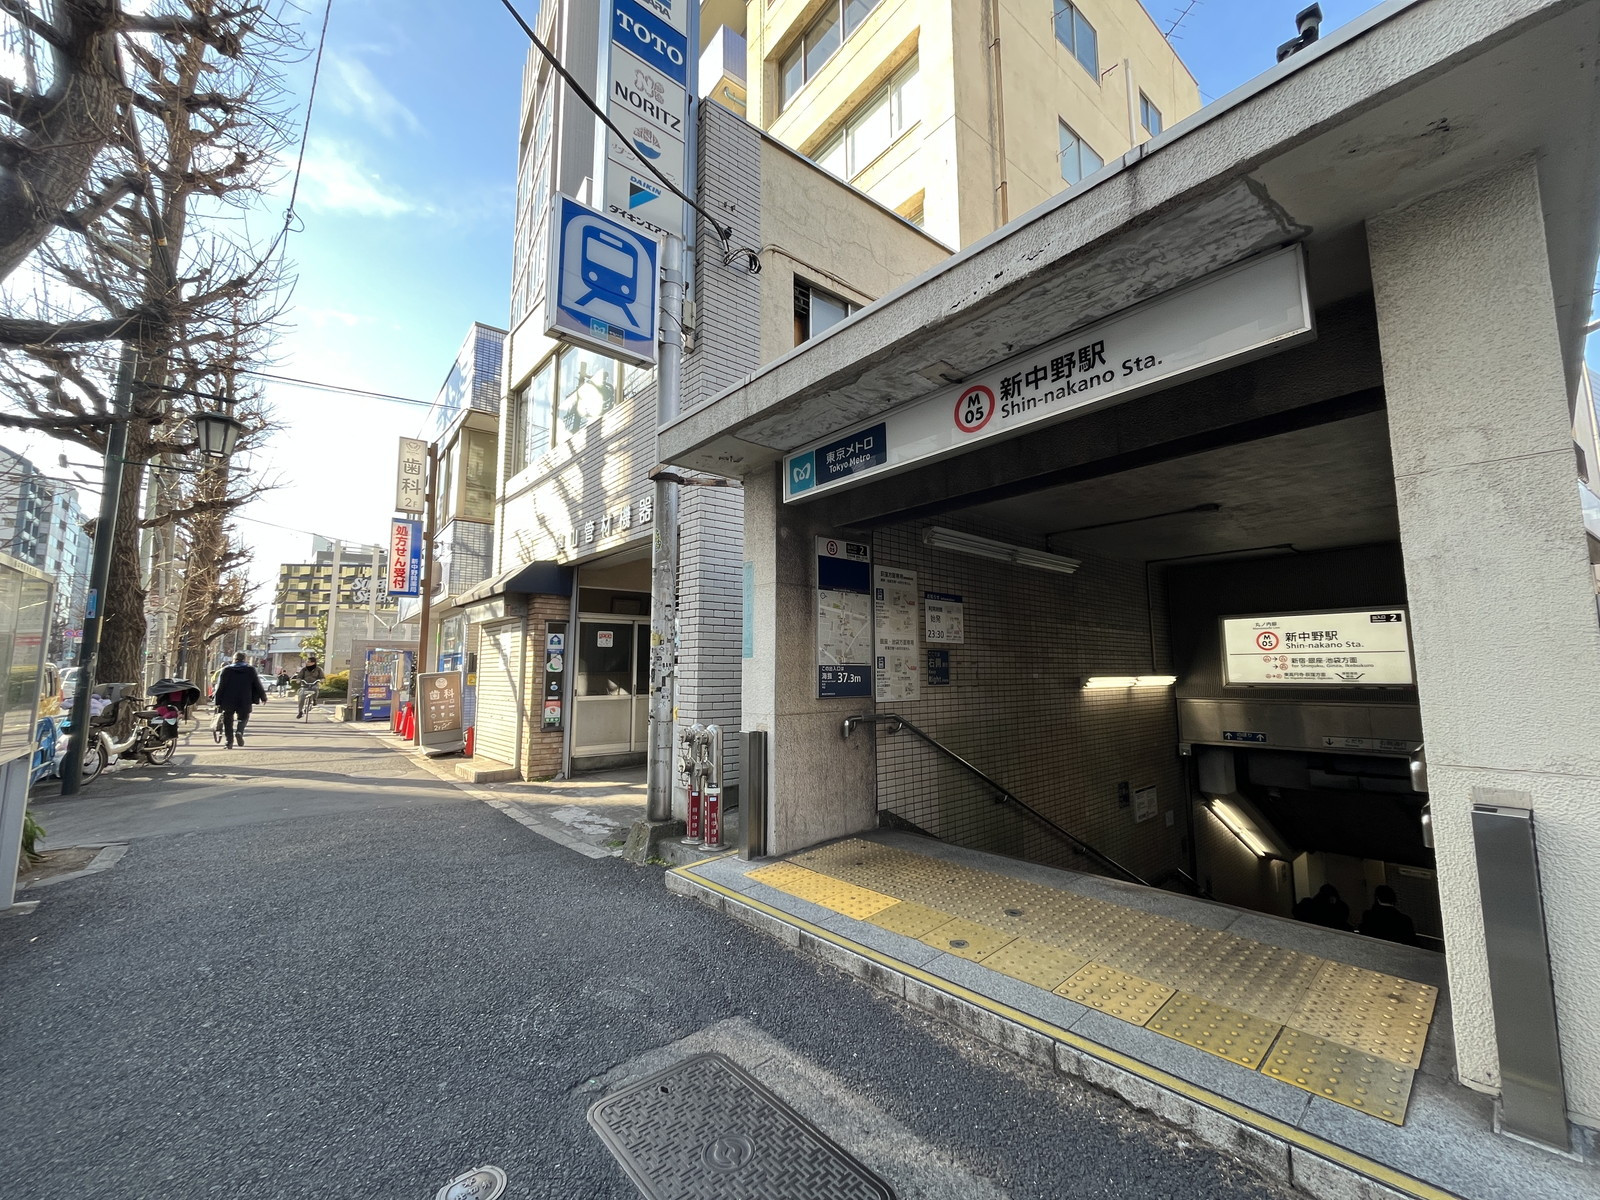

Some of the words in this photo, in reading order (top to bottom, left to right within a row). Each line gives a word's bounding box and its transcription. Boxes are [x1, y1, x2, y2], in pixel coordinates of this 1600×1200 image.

[645, 0, 671, 20] ARA
[616, 9, 684, 66] TOTO
[615, 80, 681, 133] NORITZ
[629, 176, 662, 196] DAIKIN
[609, 204, 673, 237] ダイキンエアコ
[1000, 340, 1107, 402] 新中野駅
[1001, 369, 1115, 419] Shin-nakano
[1123, 354, 1164, 378] Sta.
[968, 393, 981, 407] M
[964, 408, 985, 425] 05
[826, 436, 874, 465] 東京メトロ
[829, 460, 849, 474] Tokyo
[849, 453, 871, 469] Metro
[401, 458, 423, 496] 歯科
[404, 497, 418, 508] 2F
[392, 525, 409, 589] 処方せん受付
[860, 546, 865, 556] 2
[1390, 614, 1398, 622] 2
[927, 629, 945, 639] 23:30
[1284, 630, 1338, 643] 新中野駅
[1285, 641, 1343, 650] Shin-nakano
[1345, 640, 1365, 648] Sta.
[837, 672, 862, 683] 37.3m
[429, 688, 455, 701] 歯科
